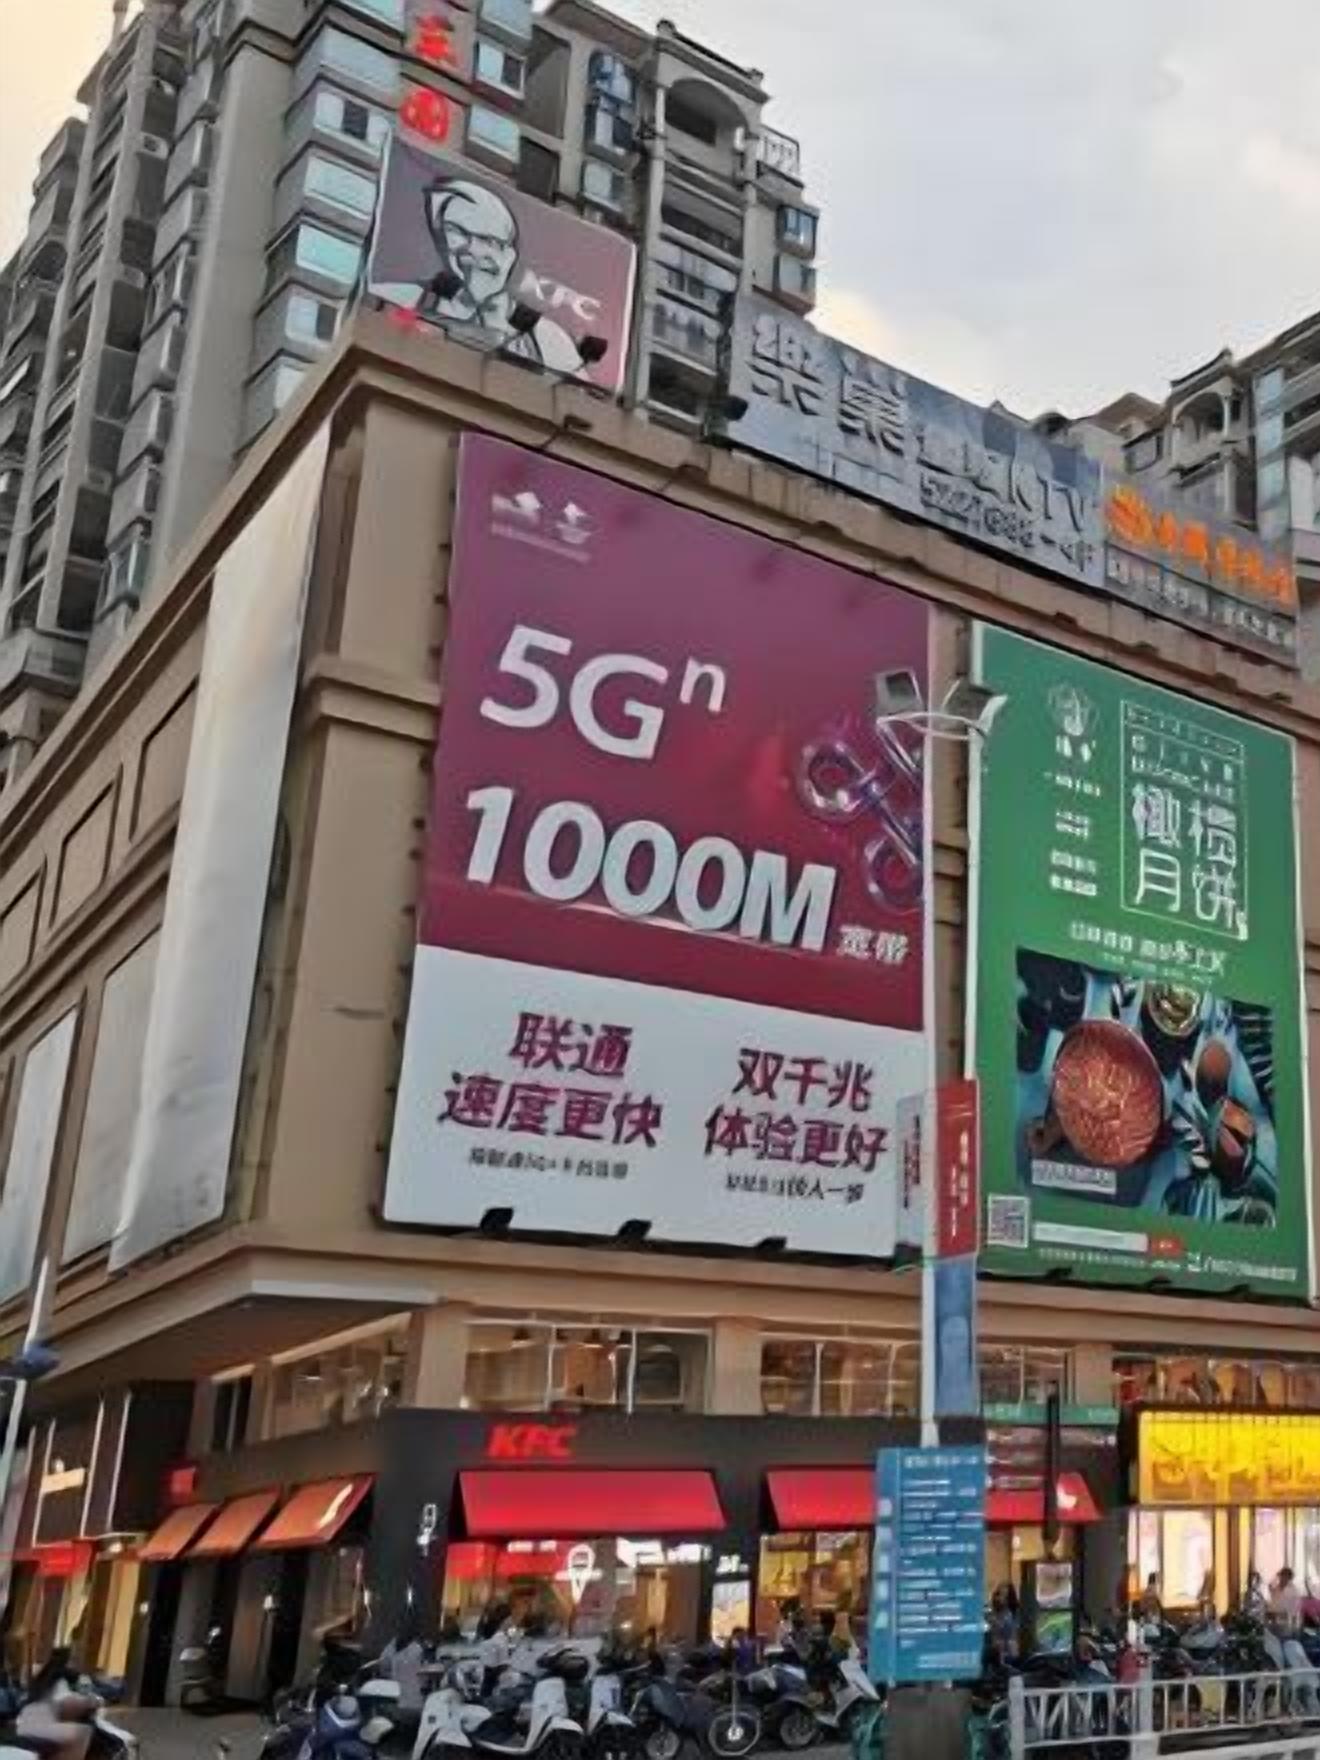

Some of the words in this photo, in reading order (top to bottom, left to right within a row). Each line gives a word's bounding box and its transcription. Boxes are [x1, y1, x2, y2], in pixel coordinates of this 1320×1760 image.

[519, 268, 601, 321] KFC
[466, 786, 837, 952] 1000M
[1136, 848, 1237, 929] 月饼
[509, 1011, 633, 1079] 联通
[436, 1071, 664, 1149] 速度更快
[731, 1047, 875, 1113] 双千兆
[703, 1104, 889, 1174] 体验更好
[488, 1423, 577, 1458] KFC
